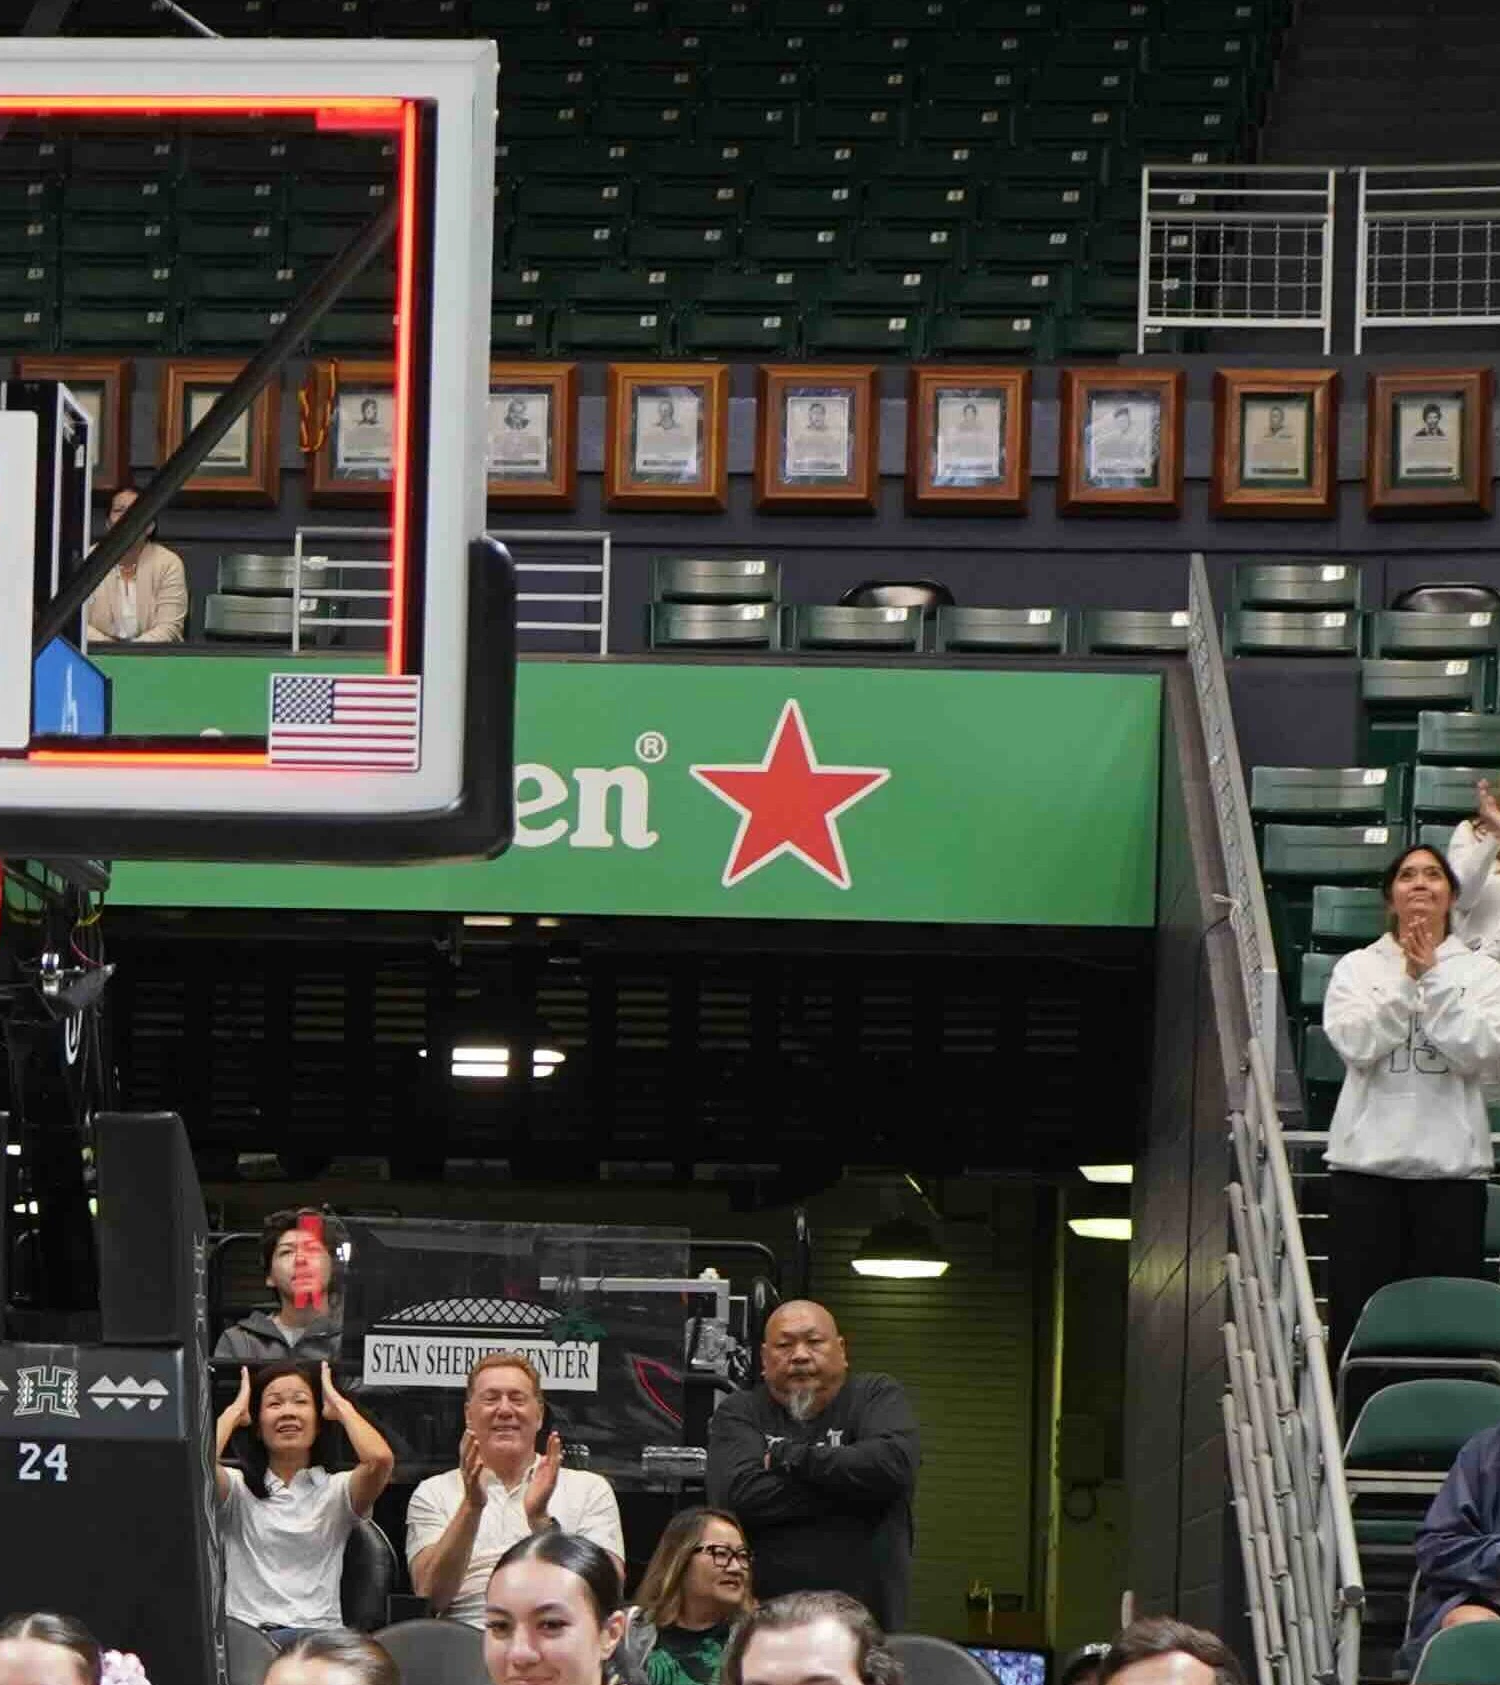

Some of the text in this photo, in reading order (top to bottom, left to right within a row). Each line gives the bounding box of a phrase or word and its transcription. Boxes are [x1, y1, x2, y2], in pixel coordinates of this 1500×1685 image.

[371, 1343, 590, 1379] STAN SHERI ENTER
[17, 1441, 69, 1483] 24
